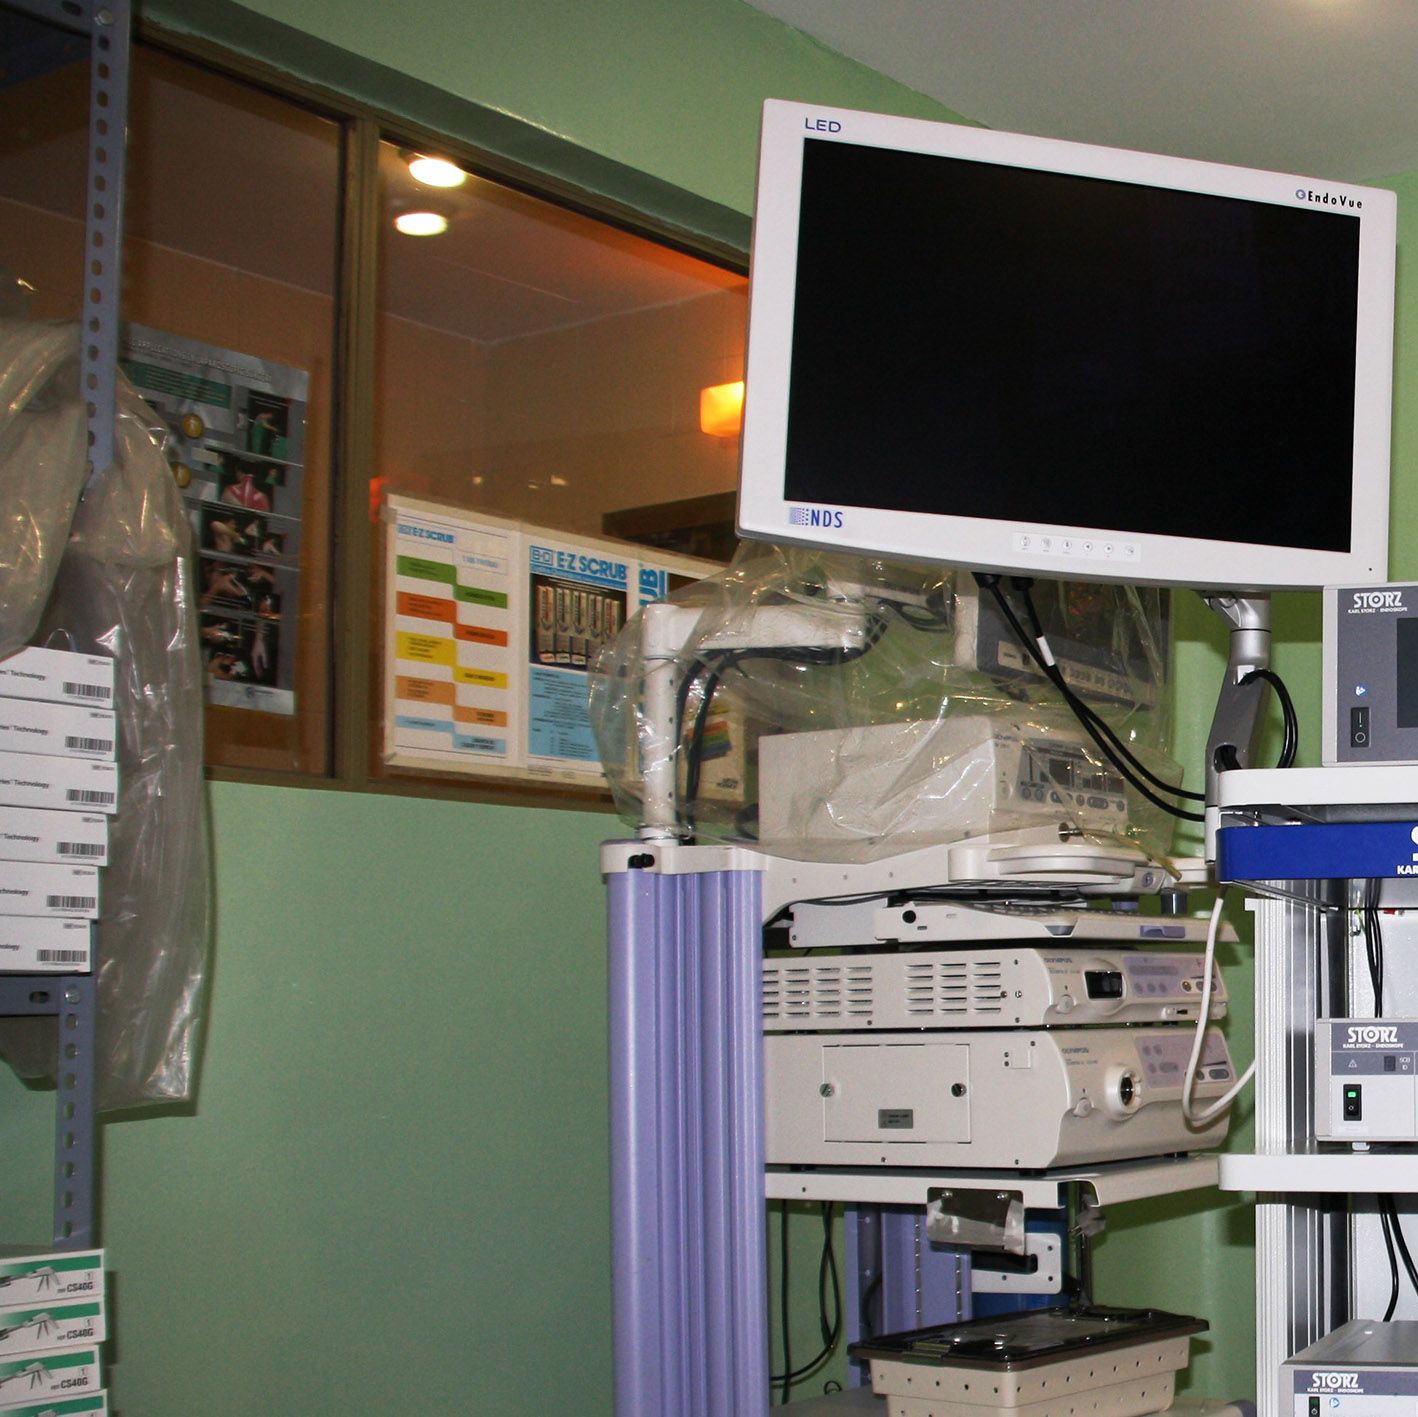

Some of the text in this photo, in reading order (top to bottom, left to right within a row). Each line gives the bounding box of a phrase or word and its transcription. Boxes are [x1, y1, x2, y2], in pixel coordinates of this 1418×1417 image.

[805, 117, 842, 133] LED
[1308, 190, 1363, 209] EndoVue
[811, 509, 843, 528] NDS
[578, 555, 628, 581] SCRUB
[1353, 591, 1402, 608] STORZ
[1348, 1026, 1398, 1043] STORZ
[67, 1282, 93, 1293] CS40G
[66, 1328, 94, 1341] CS40G
[61, 1377, 88, 1389] CS40G
[1312, 1372, 1358, 1389] STORZ
